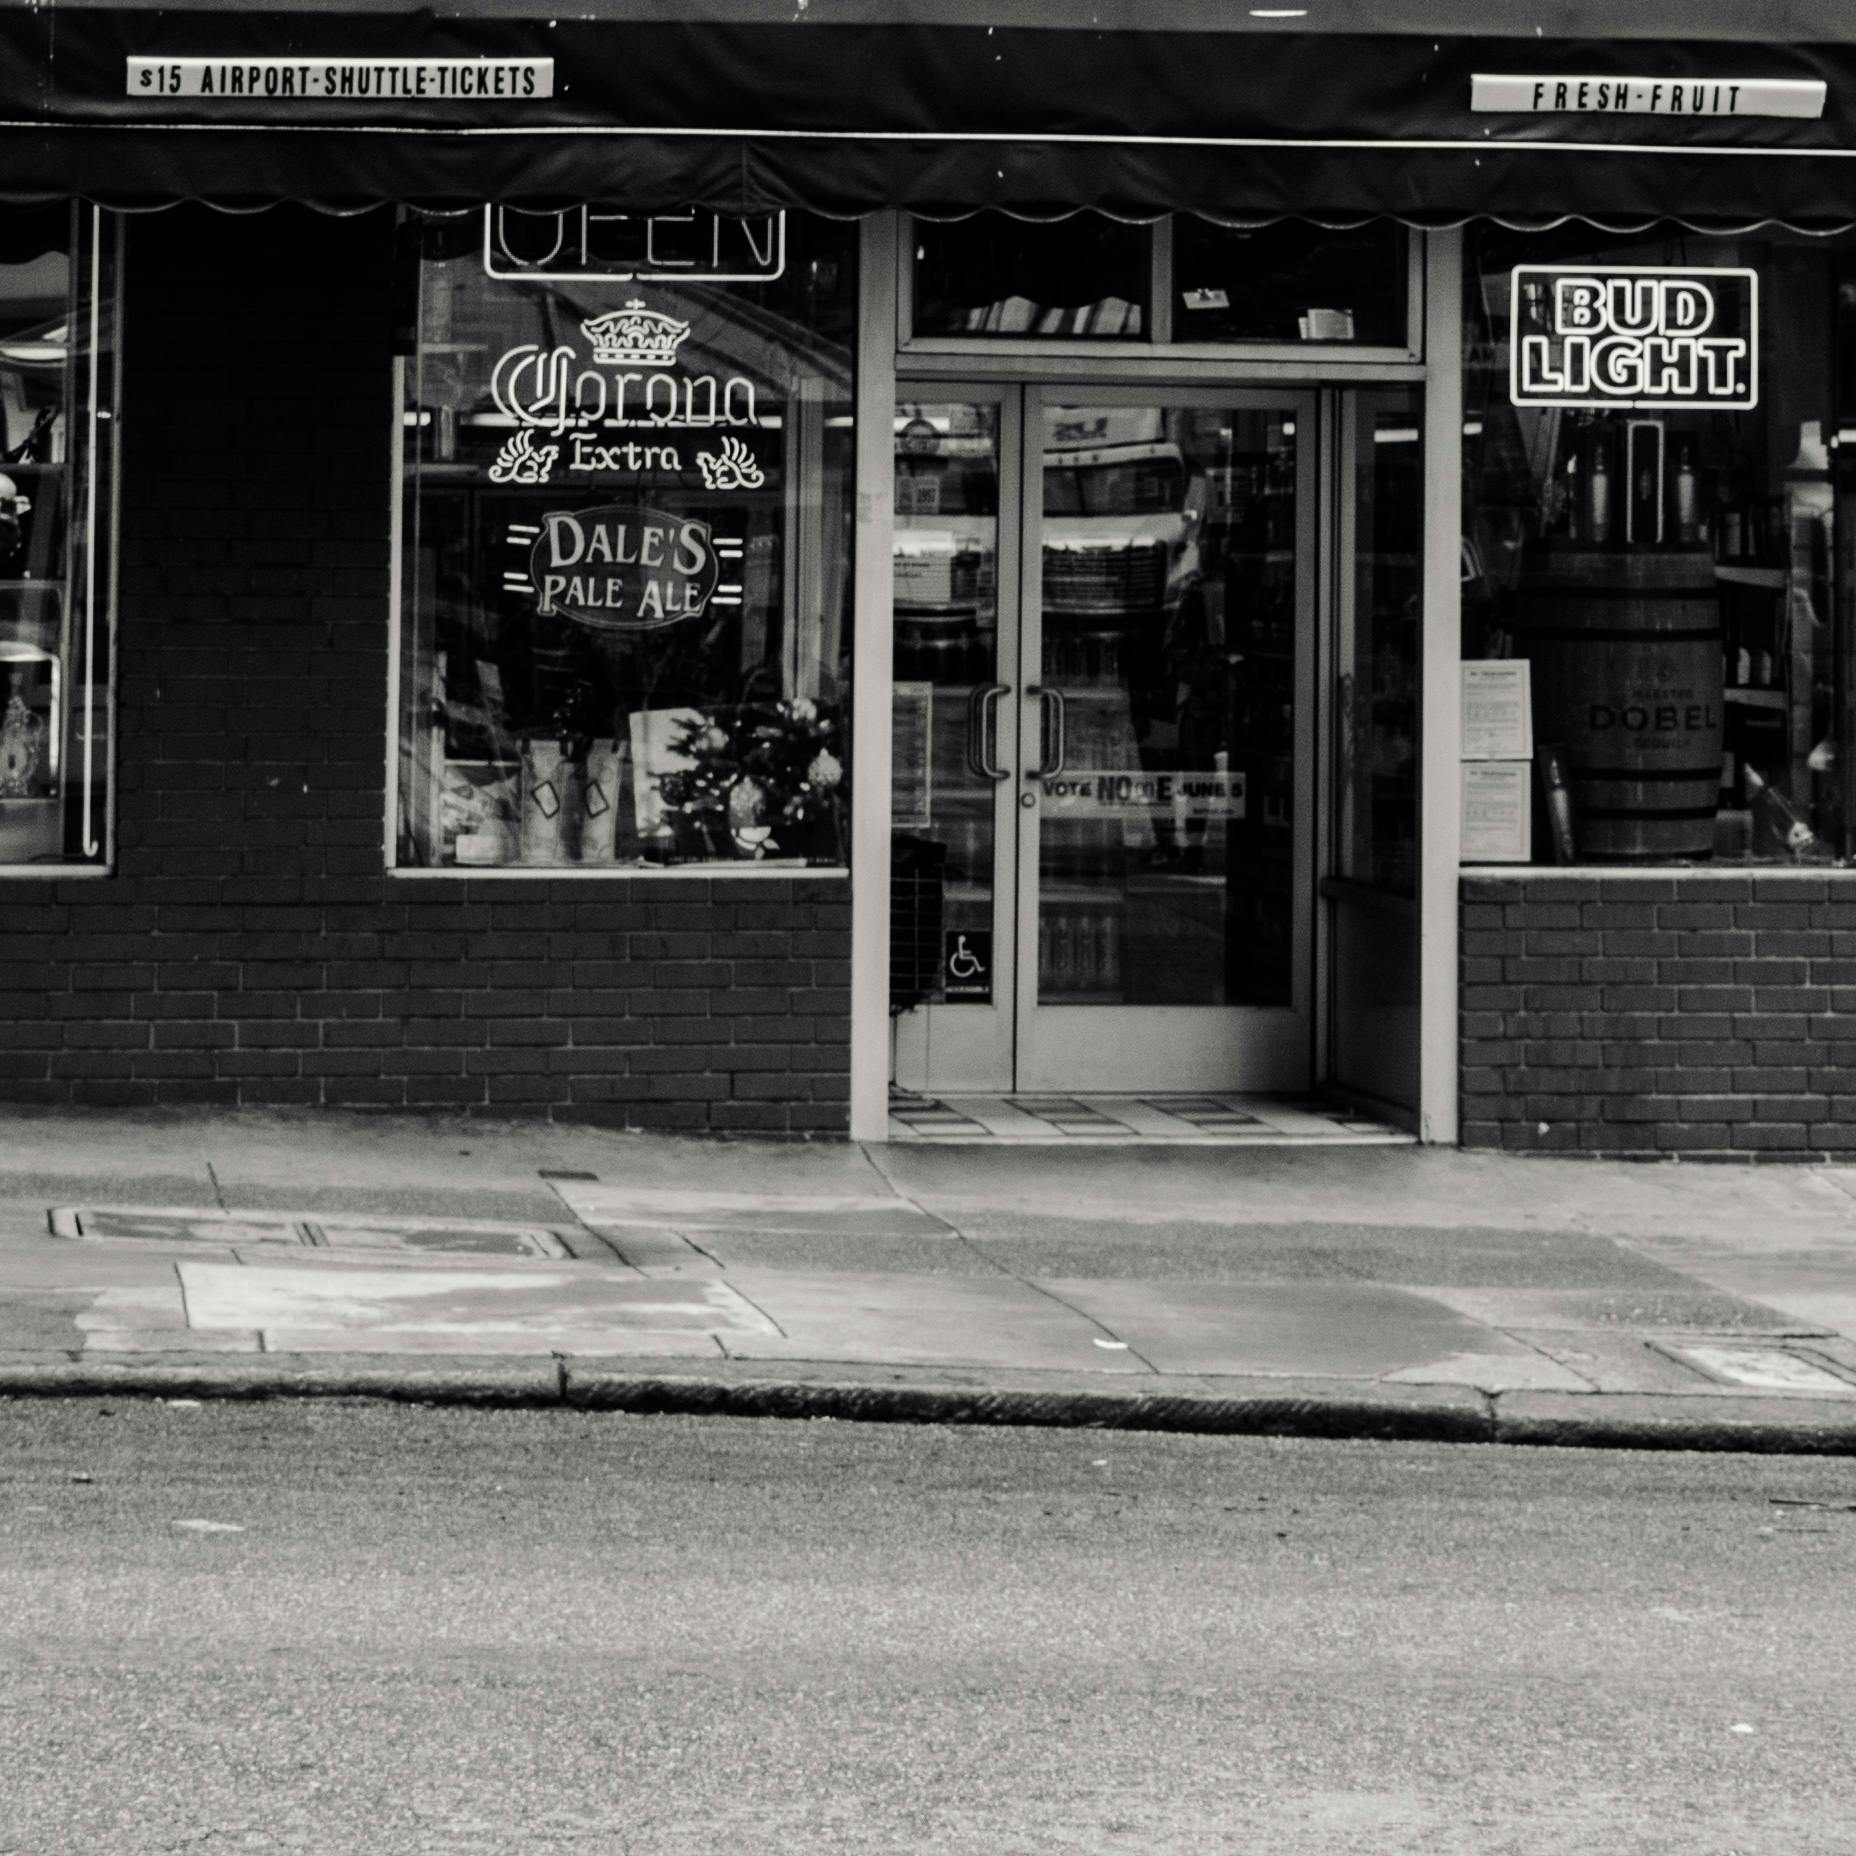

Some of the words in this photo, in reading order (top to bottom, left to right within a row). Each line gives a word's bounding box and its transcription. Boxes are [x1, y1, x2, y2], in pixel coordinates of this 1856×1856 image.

[1533, 81, 1741, 114] FRESH-FRUIT
[1555, 278, 1715, 337] BUD
[490, 344, 762, 437] Corona
[569, 431, 682, 471] Extra
[545, 514, 711, 576] DALE'S
[542, 574, 624, 612] PALE
[637, 578, 704, 619] ALE
[1589, 705, 1717, 732] DOBEL
[1041, 780, 1092, 797] VOTE
[1097, 775, 1132, 801] NO
[1179, 781, 1227, 798] JUNE
